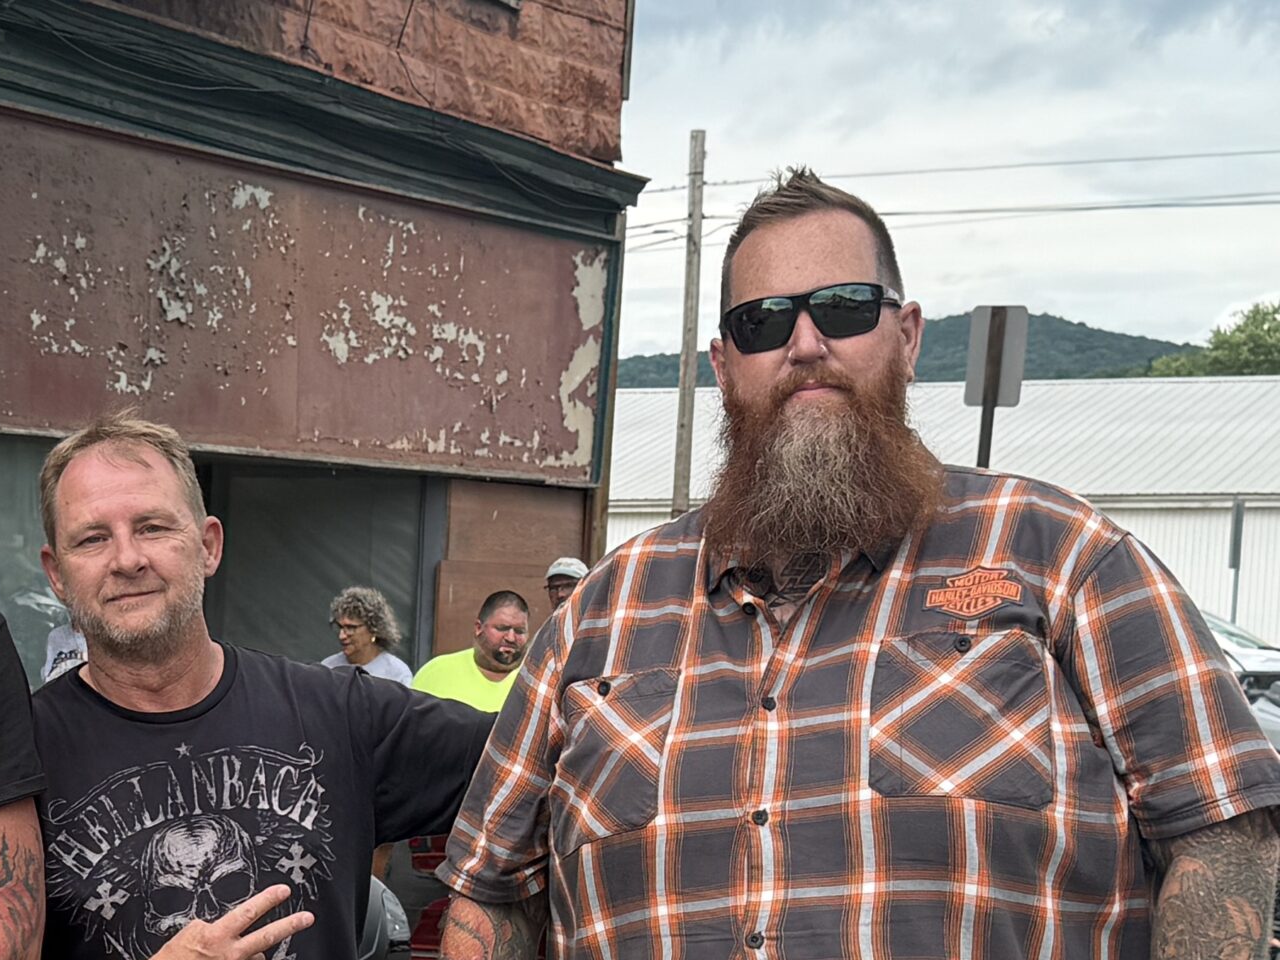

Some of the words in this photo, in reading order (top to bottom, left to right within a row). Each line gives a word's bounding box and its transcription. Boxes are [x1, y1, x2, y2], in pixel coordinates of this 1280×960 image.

[954, 571, 999, 588] MOTOR
[930, 582, 1019, 604] HARLEY-DAVIDSON
[945, 596, 995, 613] CYCLES
